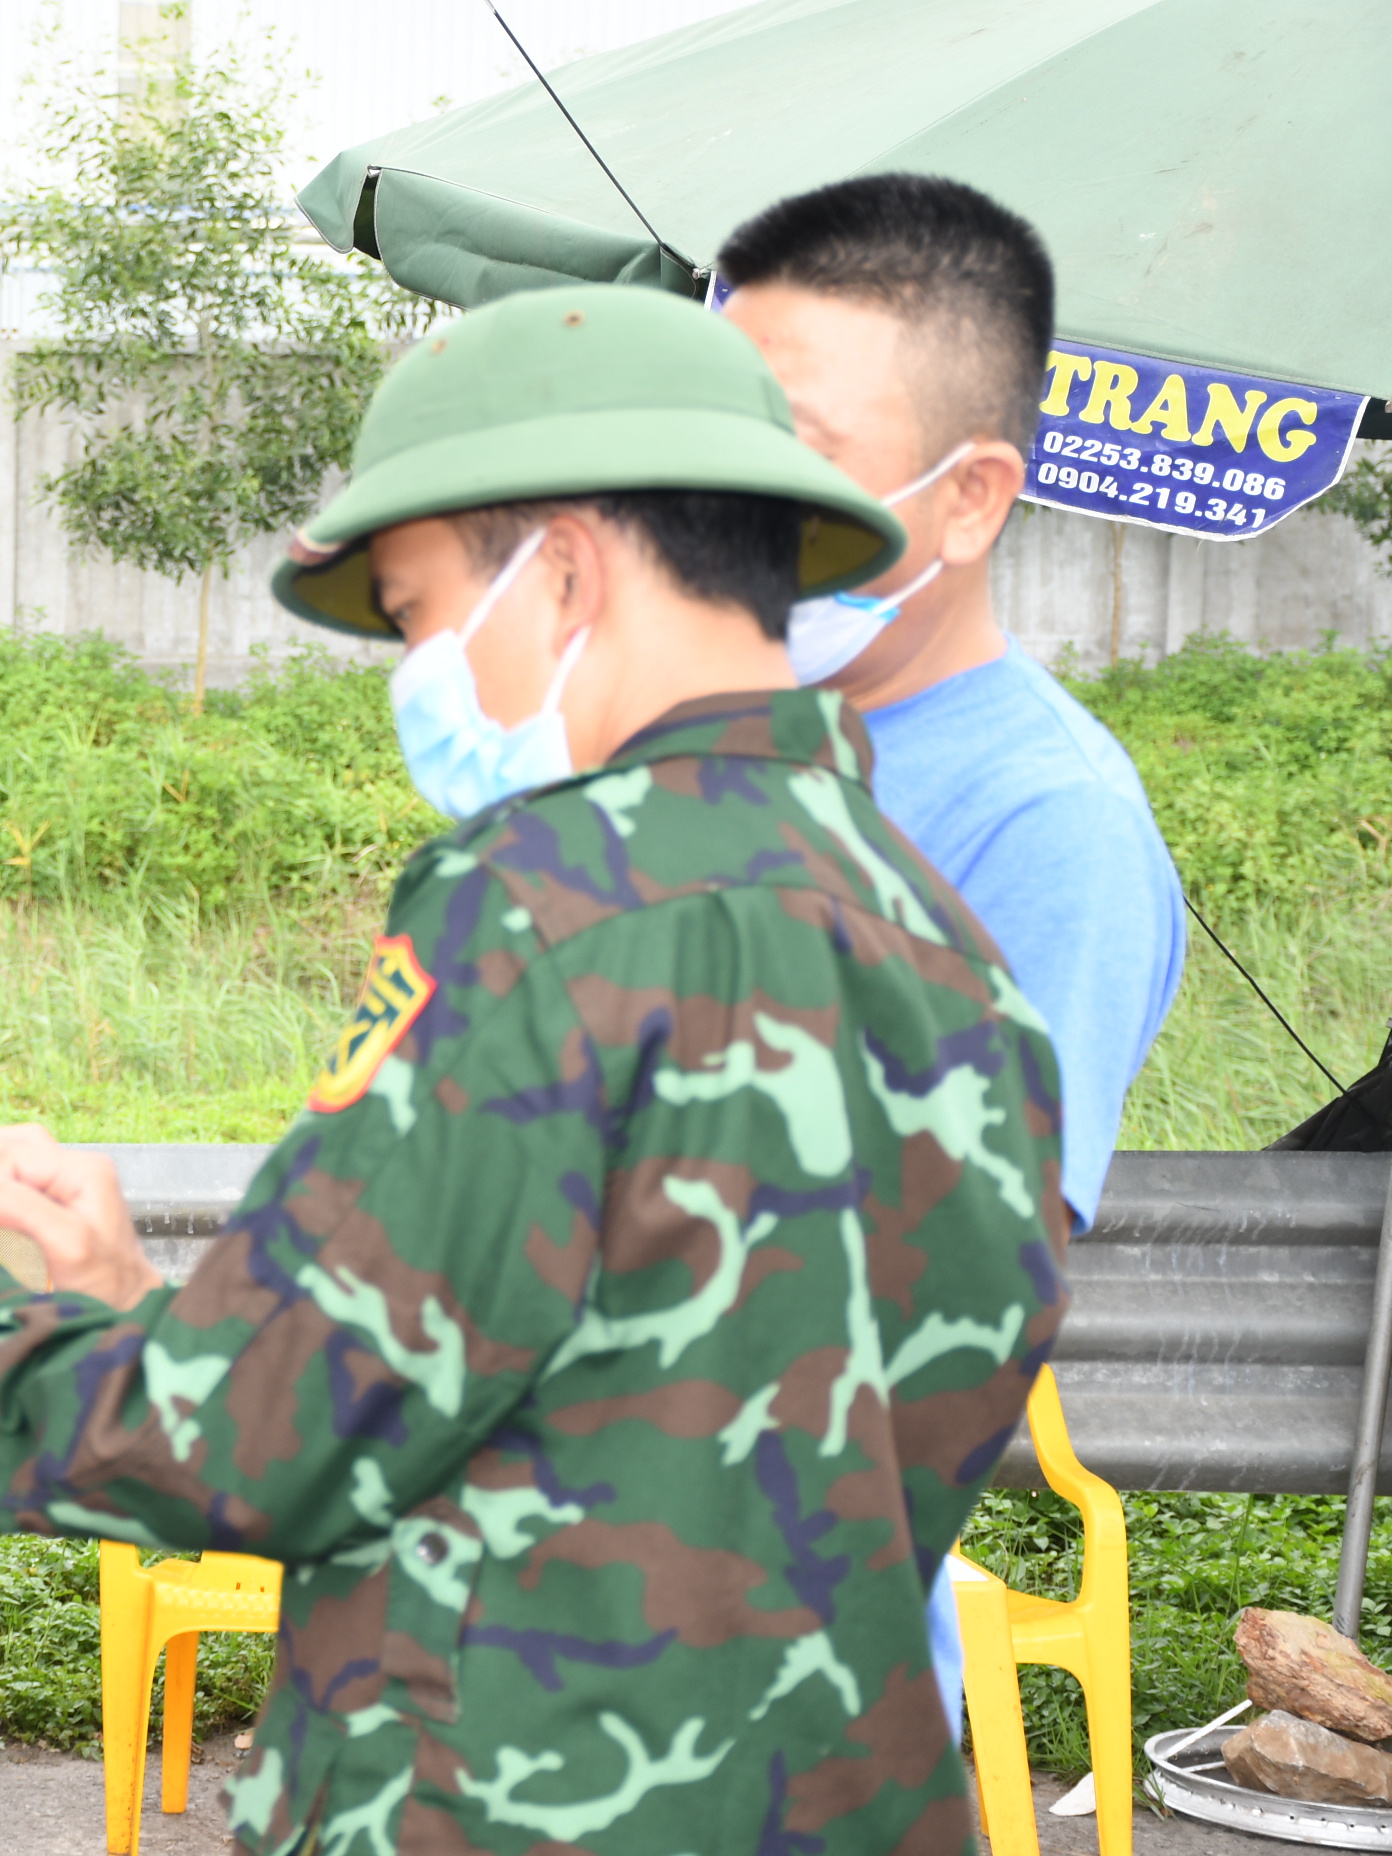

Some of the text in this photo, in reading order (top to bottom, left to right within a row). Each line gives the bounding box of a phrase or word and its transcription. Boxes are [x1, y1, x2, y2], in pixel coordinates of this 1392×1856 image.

[1038, 350, 1317, 462] TRANG
[1037, 461, 1267, 529] 0904.219.341
[1043, 431, 1286, 501] 02253.839.086
